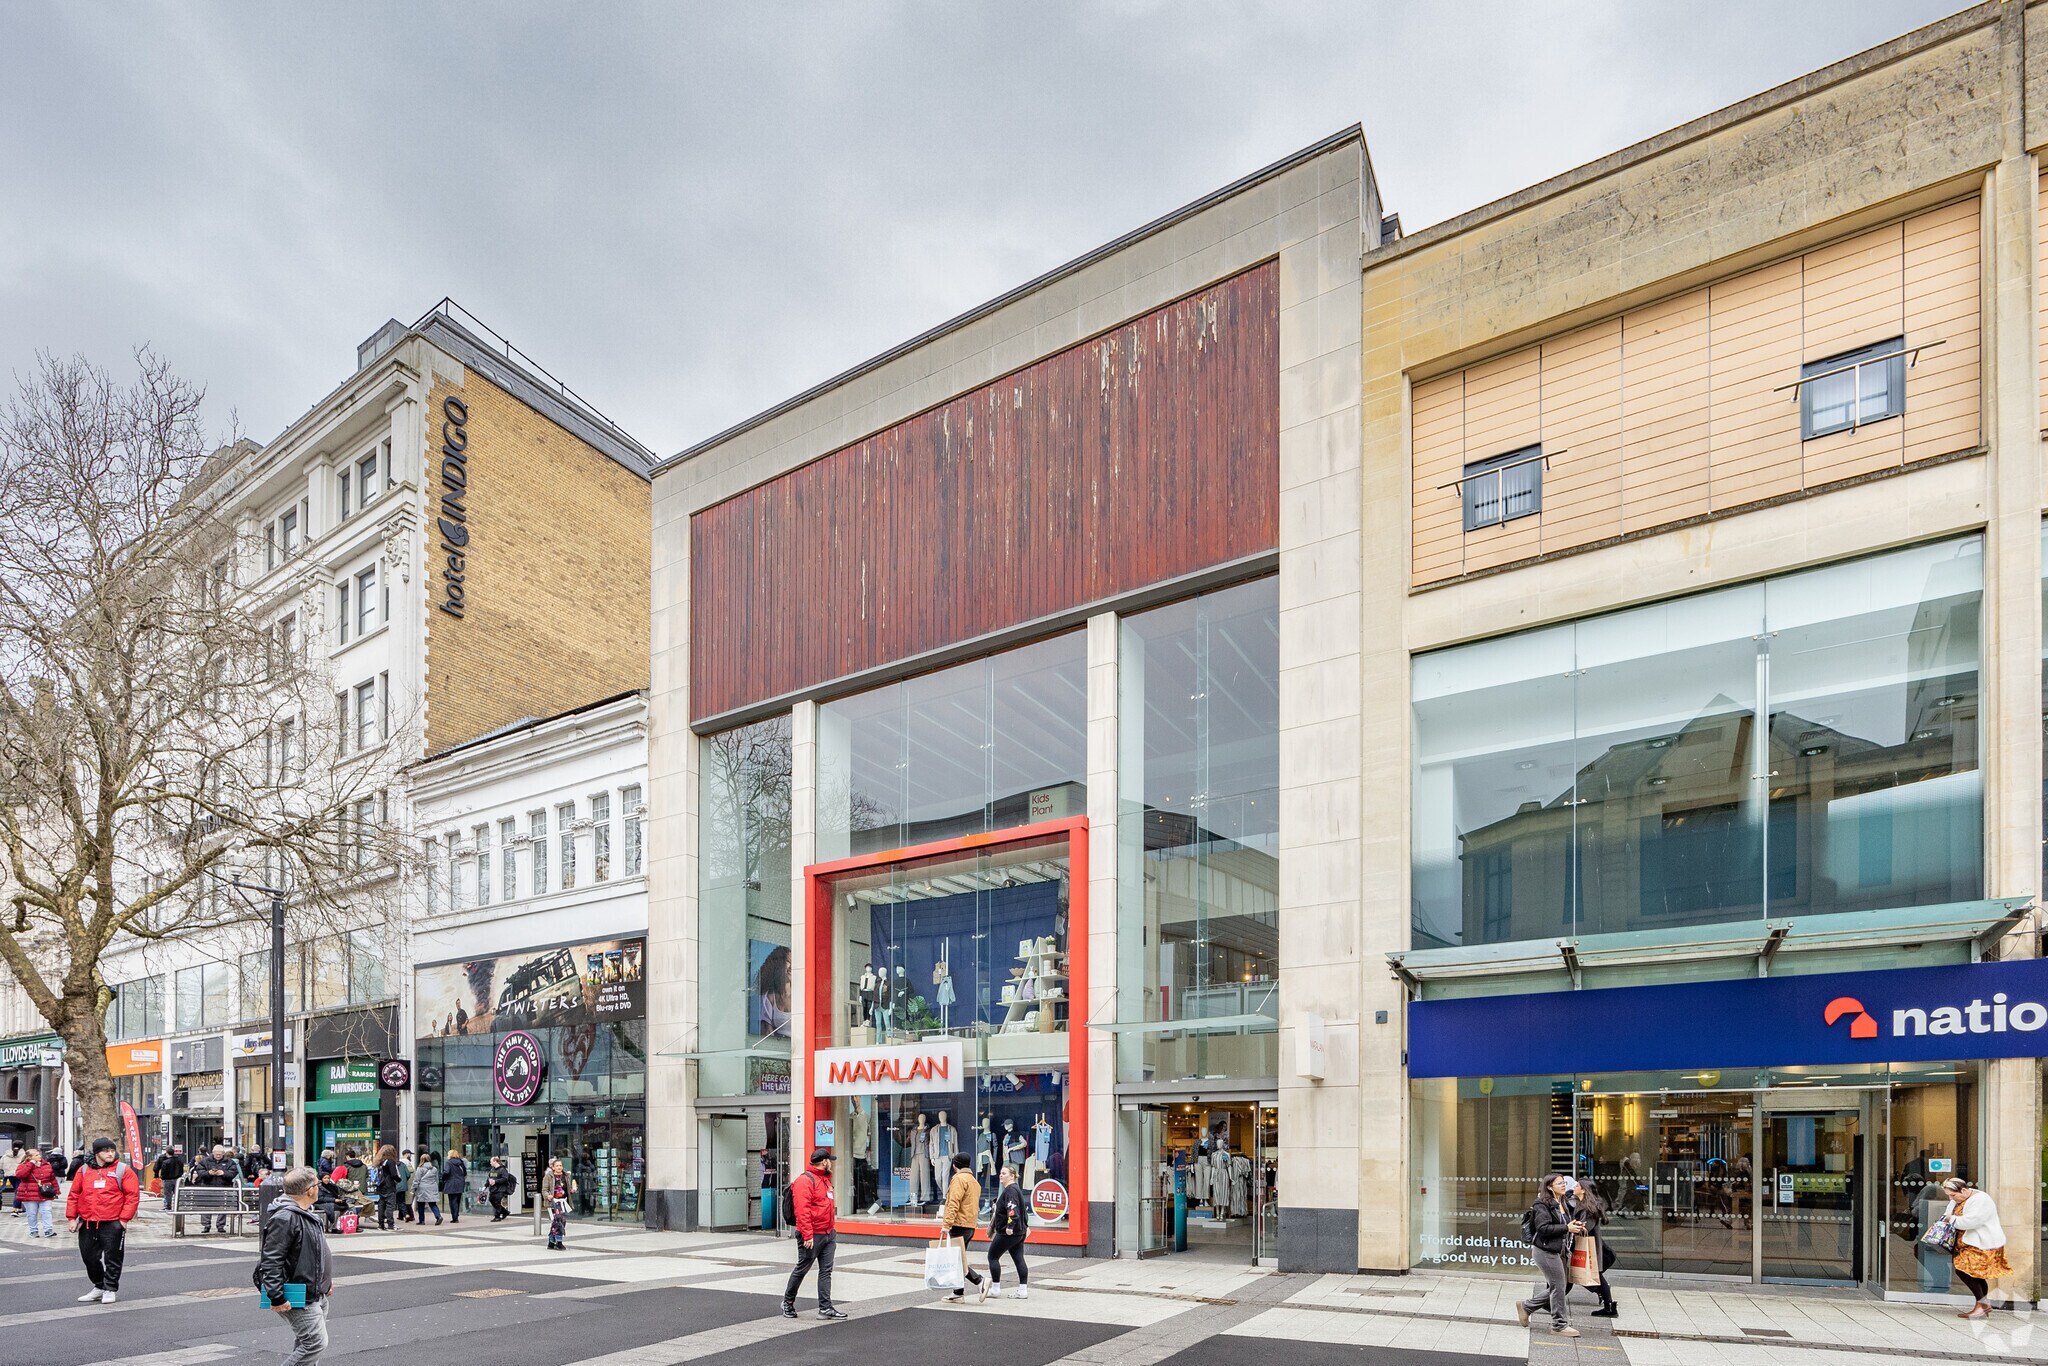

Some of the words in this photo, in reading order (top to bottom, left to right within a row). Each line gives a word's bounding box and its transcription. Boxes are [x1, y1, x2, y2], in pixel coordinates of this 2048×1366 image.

[440, 396, 468, 522] INDIGO
[439, 542, 466, 619] hotel
[1031, 794, 1050, 804] Kids
[1031, 804, 1053, 816] Plant
[501, 993, 578, 1016] TWISTERS
[606, 993, 619, 1002] Ultra
[596, 1003, 614, 1013] Blu-ray
[620, 1001, 632, 1010] DVD
[1893, 992, 2048, 1037] natio
[3, 1045, 27, 1063] LLOYDS
[496, 1047, 507, 1069] THE
[505, 1035, 524, 1049] HMV
[523, 1039, 538, 1067] SHOP
[828, 1055, 948, 1084] MATALAN
[761, 1073, 779, 1082] HERE
[779, 1075, 791, 1083] CO
[330, 1082, 374, 1094] PAWNBROKERS
[502, 1086, 516, 1102] EST.
[516, 1085, 532, 1102] 1921
[761, 1082, 774, 1090] THE
[128, 1120, 140, 1158] TANNING
[1038, 1192, 1061, 1202] SALE
[1419, 1234, 1462, 1246] Ffordd
[1465, 1235, 1491, 1247] dda
[1493, 1236, 1498, 1248] i
[1419, 1251, 1430, 1262] A
[1432, 1251, 1467, 1264] good
[1469, 1254, 1499, 1266] way
[1501, 1254, 1517, 1265] to
